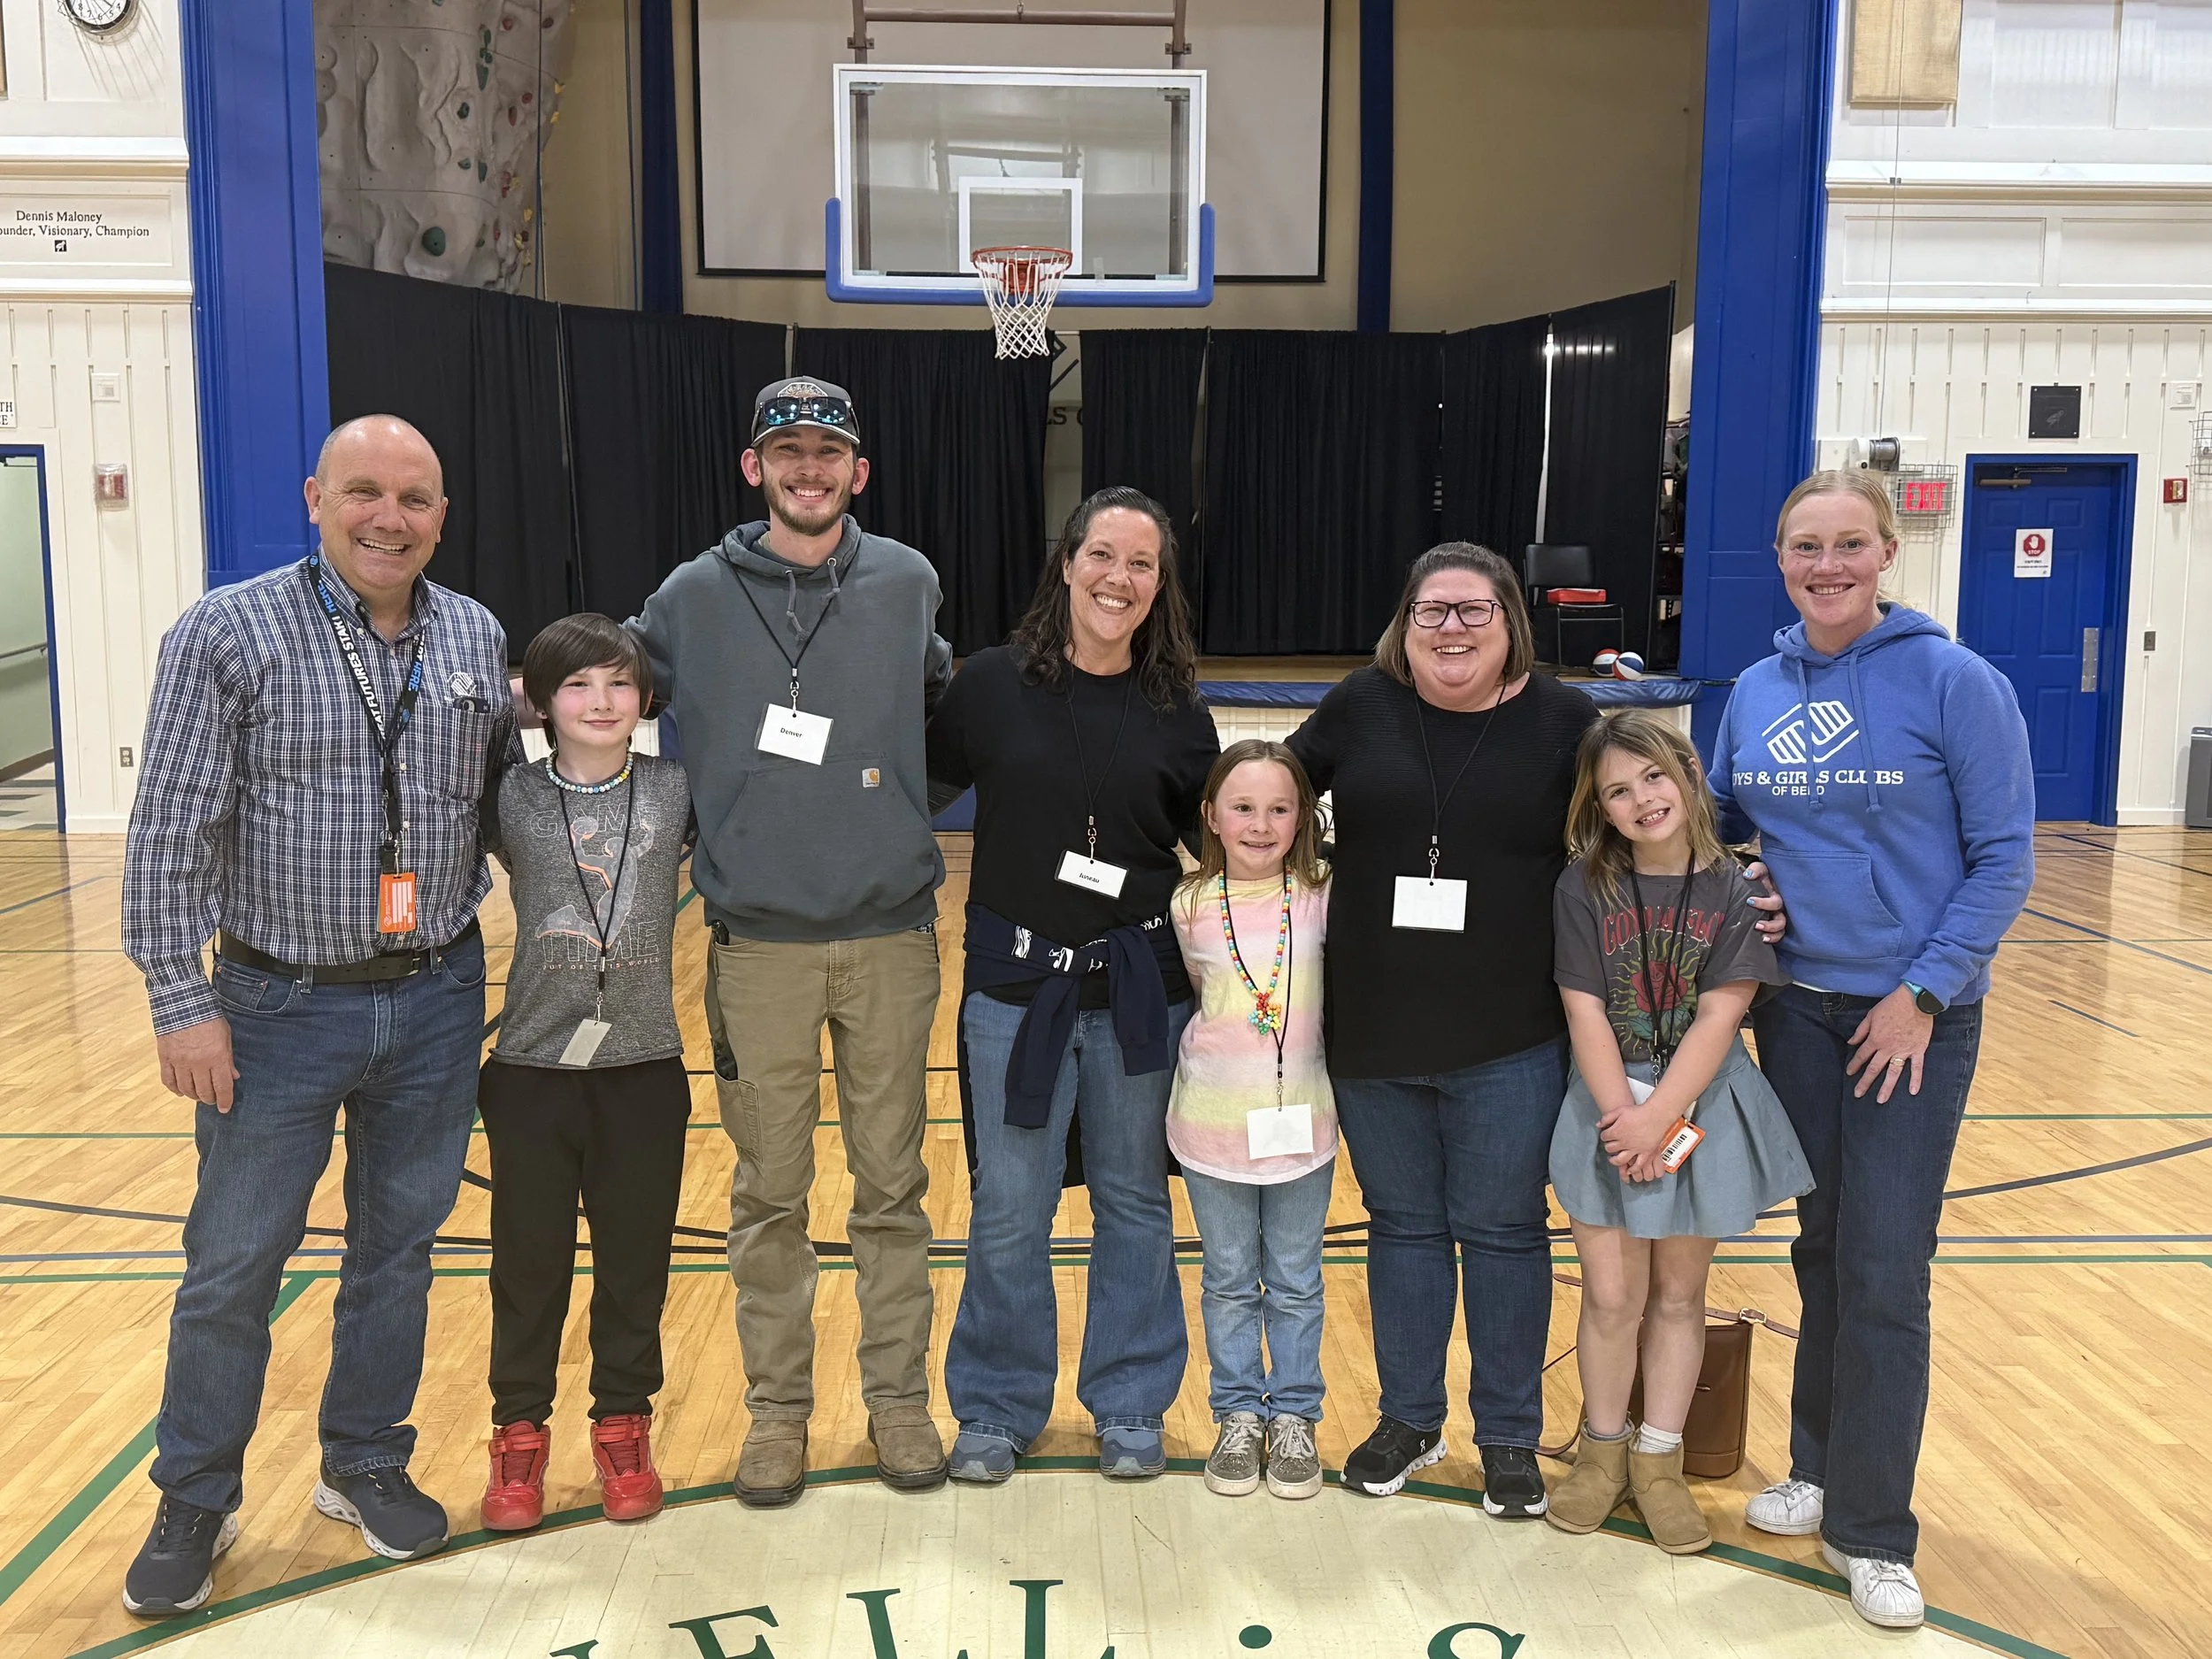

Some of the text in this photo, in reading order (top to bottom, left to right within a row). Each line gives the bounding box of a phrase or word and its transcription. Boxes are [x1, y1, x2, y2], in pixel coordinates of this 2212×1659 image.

[16, 211, 103, 224] Dennis Maloney
[38, 225, 92, 238] Visionary,
[96, 226, 150, 238] Champion
[1905, 481, 1947, 511] EXIT
[347, 651, 379, 708] FUTURES
[780, 727, 803, 738] Denver
[1732, 772, 1753, 786] OYS
[1756, 772, 1771, 785] &
[1775, 771, 1830, 785] GIRS
[1771, 785, 1825, 796] OF BED
